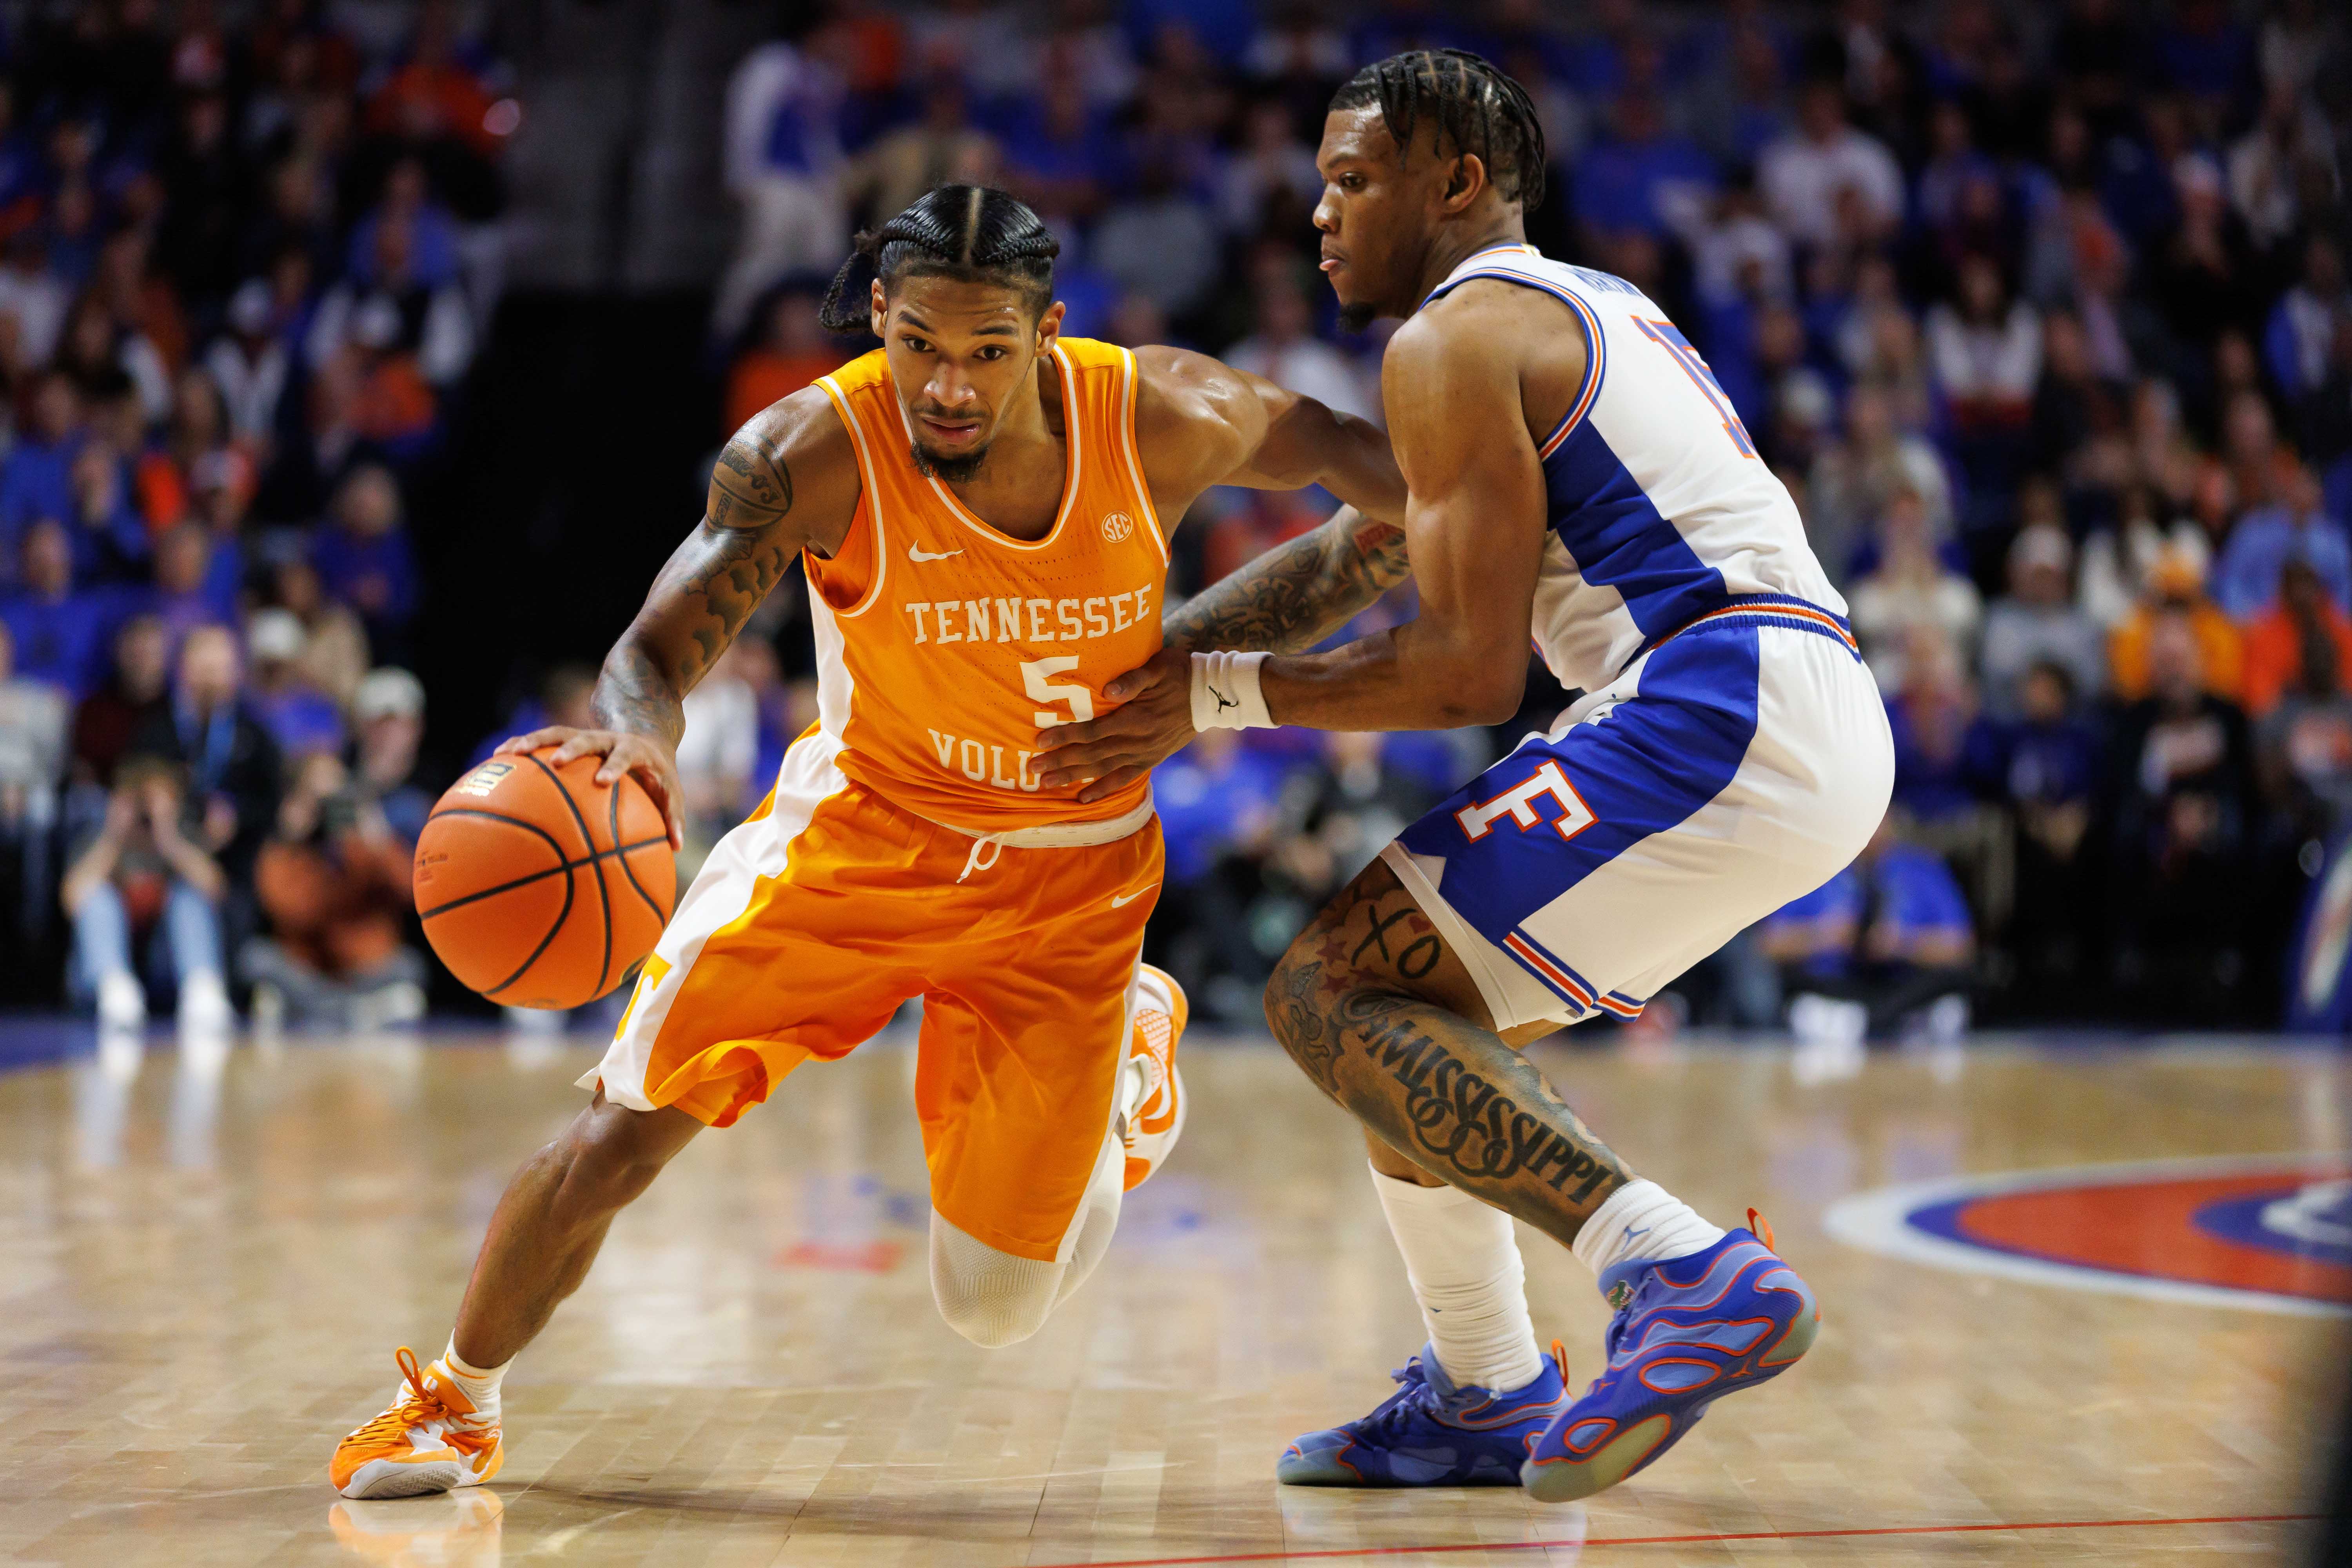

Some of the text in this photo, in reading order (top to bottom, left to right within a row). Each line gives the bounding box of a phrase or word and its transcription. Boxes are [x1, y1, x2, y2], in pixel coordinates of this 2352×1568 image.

[1105, 514, 1130, 540] SEC
[906, 584, 1152, 644] TENNESSEE
[1020, 655, 1093, 728] 5
[1453, 758, 1600, 844] F
[1351, 904, 1441, 979] XO
[1365, 1020, 1615, 1205] MISSISSIPPI
